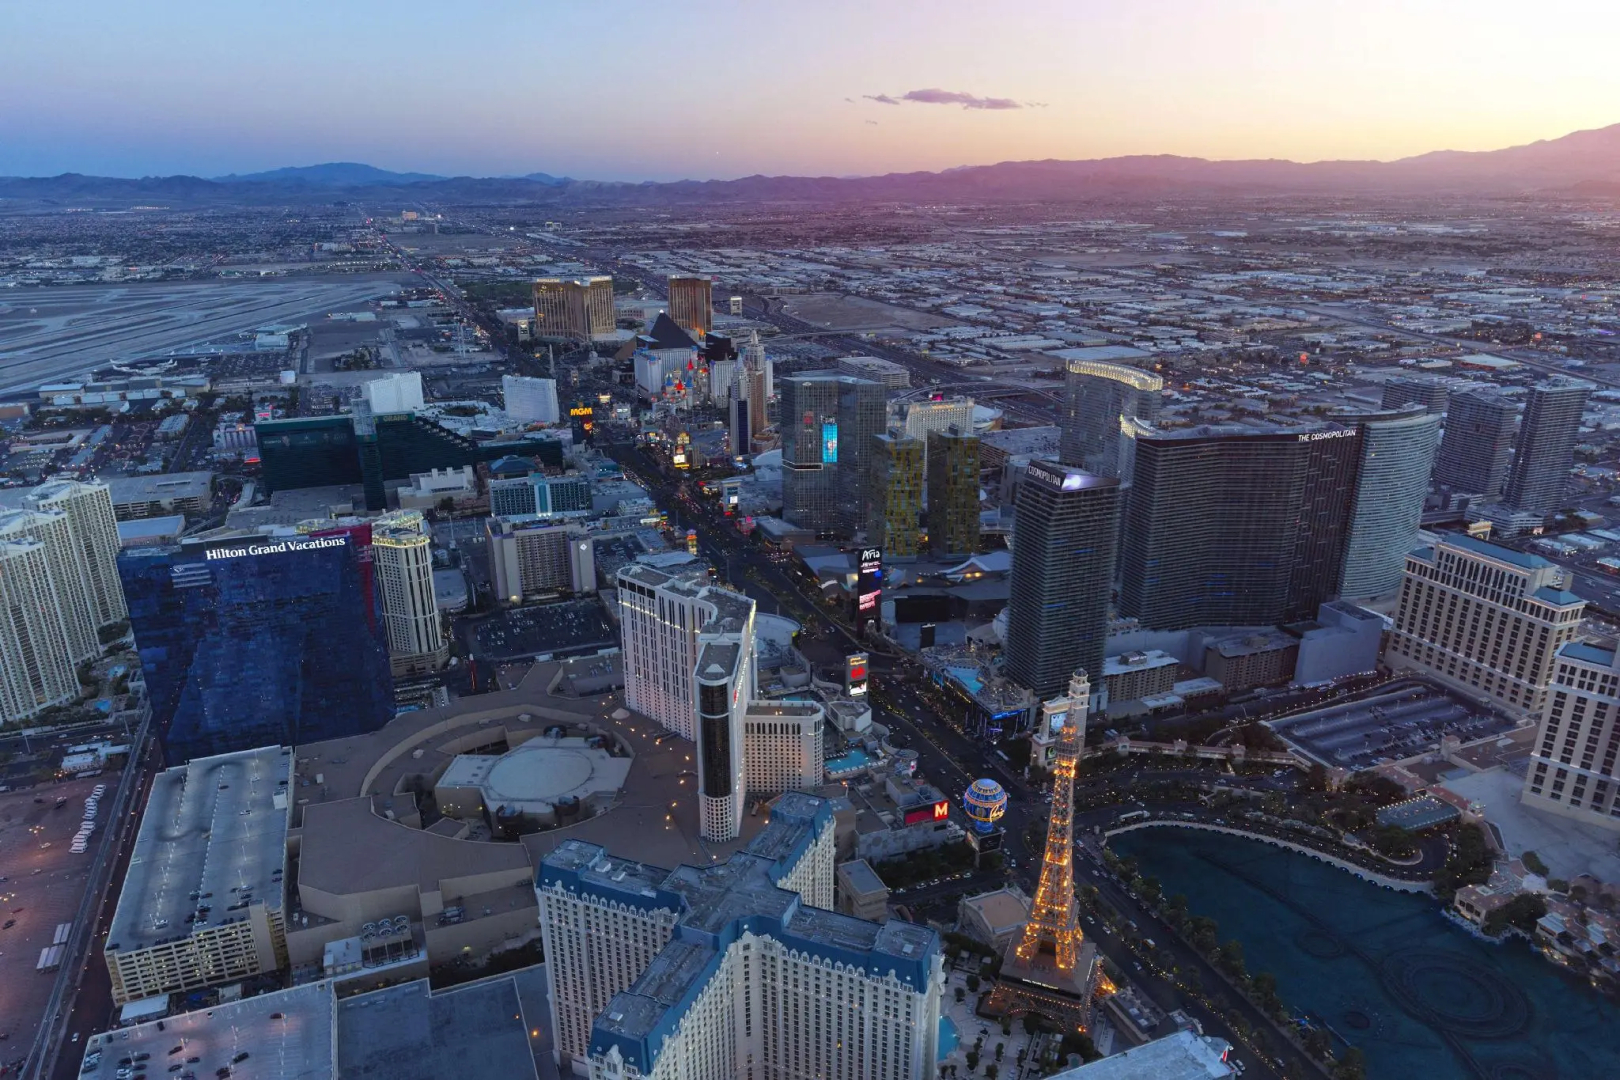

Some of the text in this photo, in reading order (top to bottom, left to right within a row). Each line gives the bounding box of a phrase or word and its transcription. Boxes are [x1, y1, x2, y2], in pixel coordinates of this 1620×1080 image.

[570, 407, 593, 416] MGM
[1298, 429, 1356, 442] THE COSMOPOLITAN
[1028, 465, 1061, 486] COSMOPOLITAN
[206, 537, 346, 560] Hilton Grand Vacations
[862, 549, 880, 561] Aria
[934, 802, 948, 818] M
